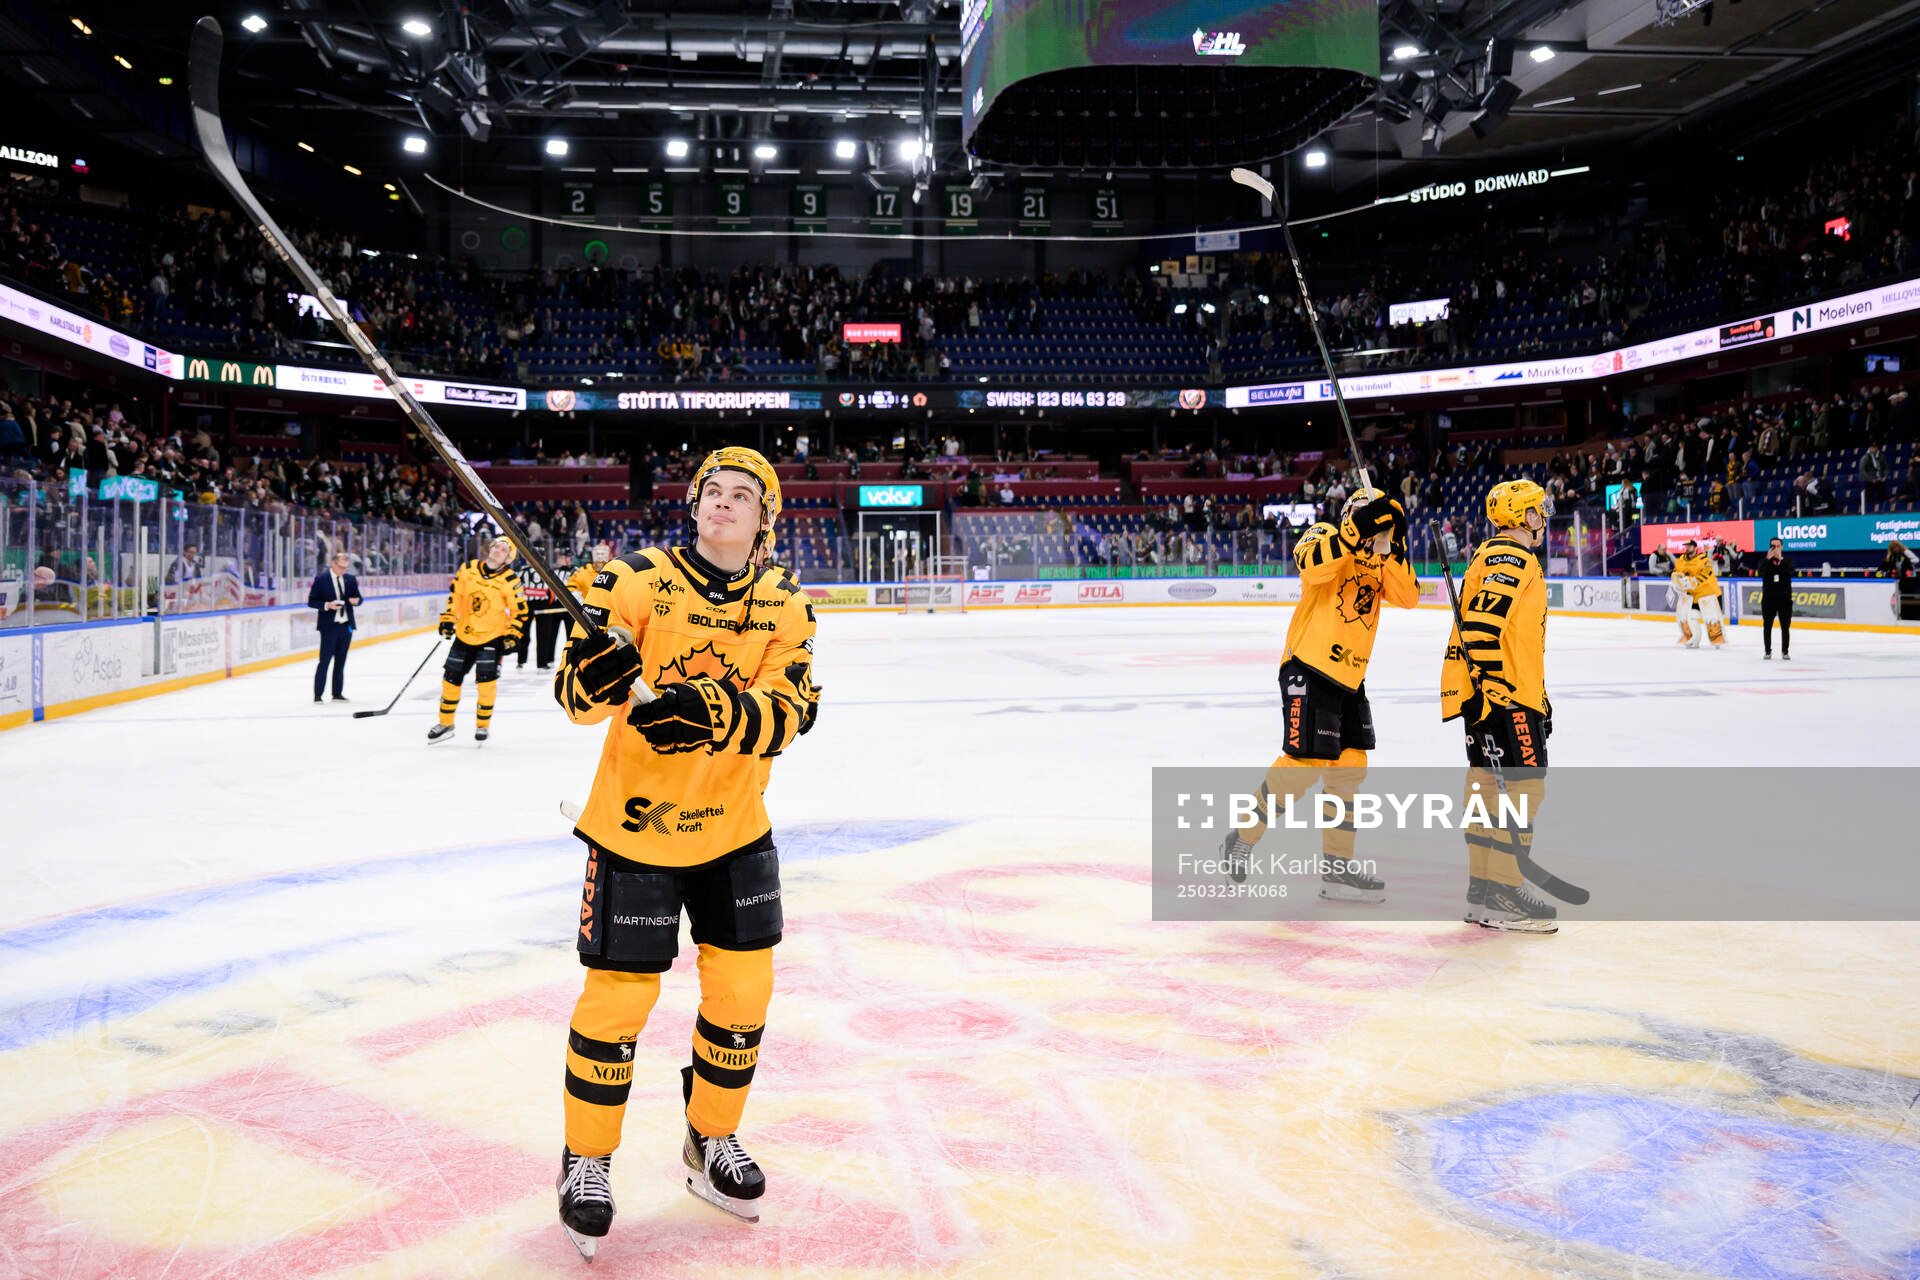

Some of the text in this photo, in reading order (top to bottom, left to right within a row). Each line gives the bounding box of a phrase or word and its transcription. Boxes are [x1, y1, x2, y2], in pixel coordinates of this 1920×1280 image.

[1410, 168, 1549, 203] STUDIO DORWARD
[571, 190, 585, 212] 2
[649, 191, 663, 213] 5
[727, 192, 741, 214] 9
[803, 192, 817, 215] 9
[875, 194, 897, 215] 17
[950, 194, 973, 216] 19
[1023, 196, 1046, 217] 21
[1096, 197, 1118, 218] 51
[1881, 286, 1920, 304] HELLQVIS
[1819, 301, 1873, 321] Moelven
[1527, 365, 1584, 378] Munkfors
[1250, 389, 1285, 400] SELMA
[1351, 381, 1392, 393] Värmland
[617, 390, 679, 409] STÖTTA
[986, 391, 1034, 407] SWISH:
[1036, 391, 1059, 406] 123
[1777, 521, 1827, 540] Lancea
[1488, 556, 1522, 567] HOLMEN
[648, 576, 685, 596] TEXOR
[709, 591, 726, 600] SHL
[1080, 586, 1121, 598] JULA
[705, 606, 727, 615] CCM
[1475, 591, 1502, 612] 17
[1290, 697, 1302, 749] REPAY
[1512, 711, 1538, 768] REPAY
[679, 804, 724, 821] Skellefteå
[676, 822, 702, 833] Kraft
